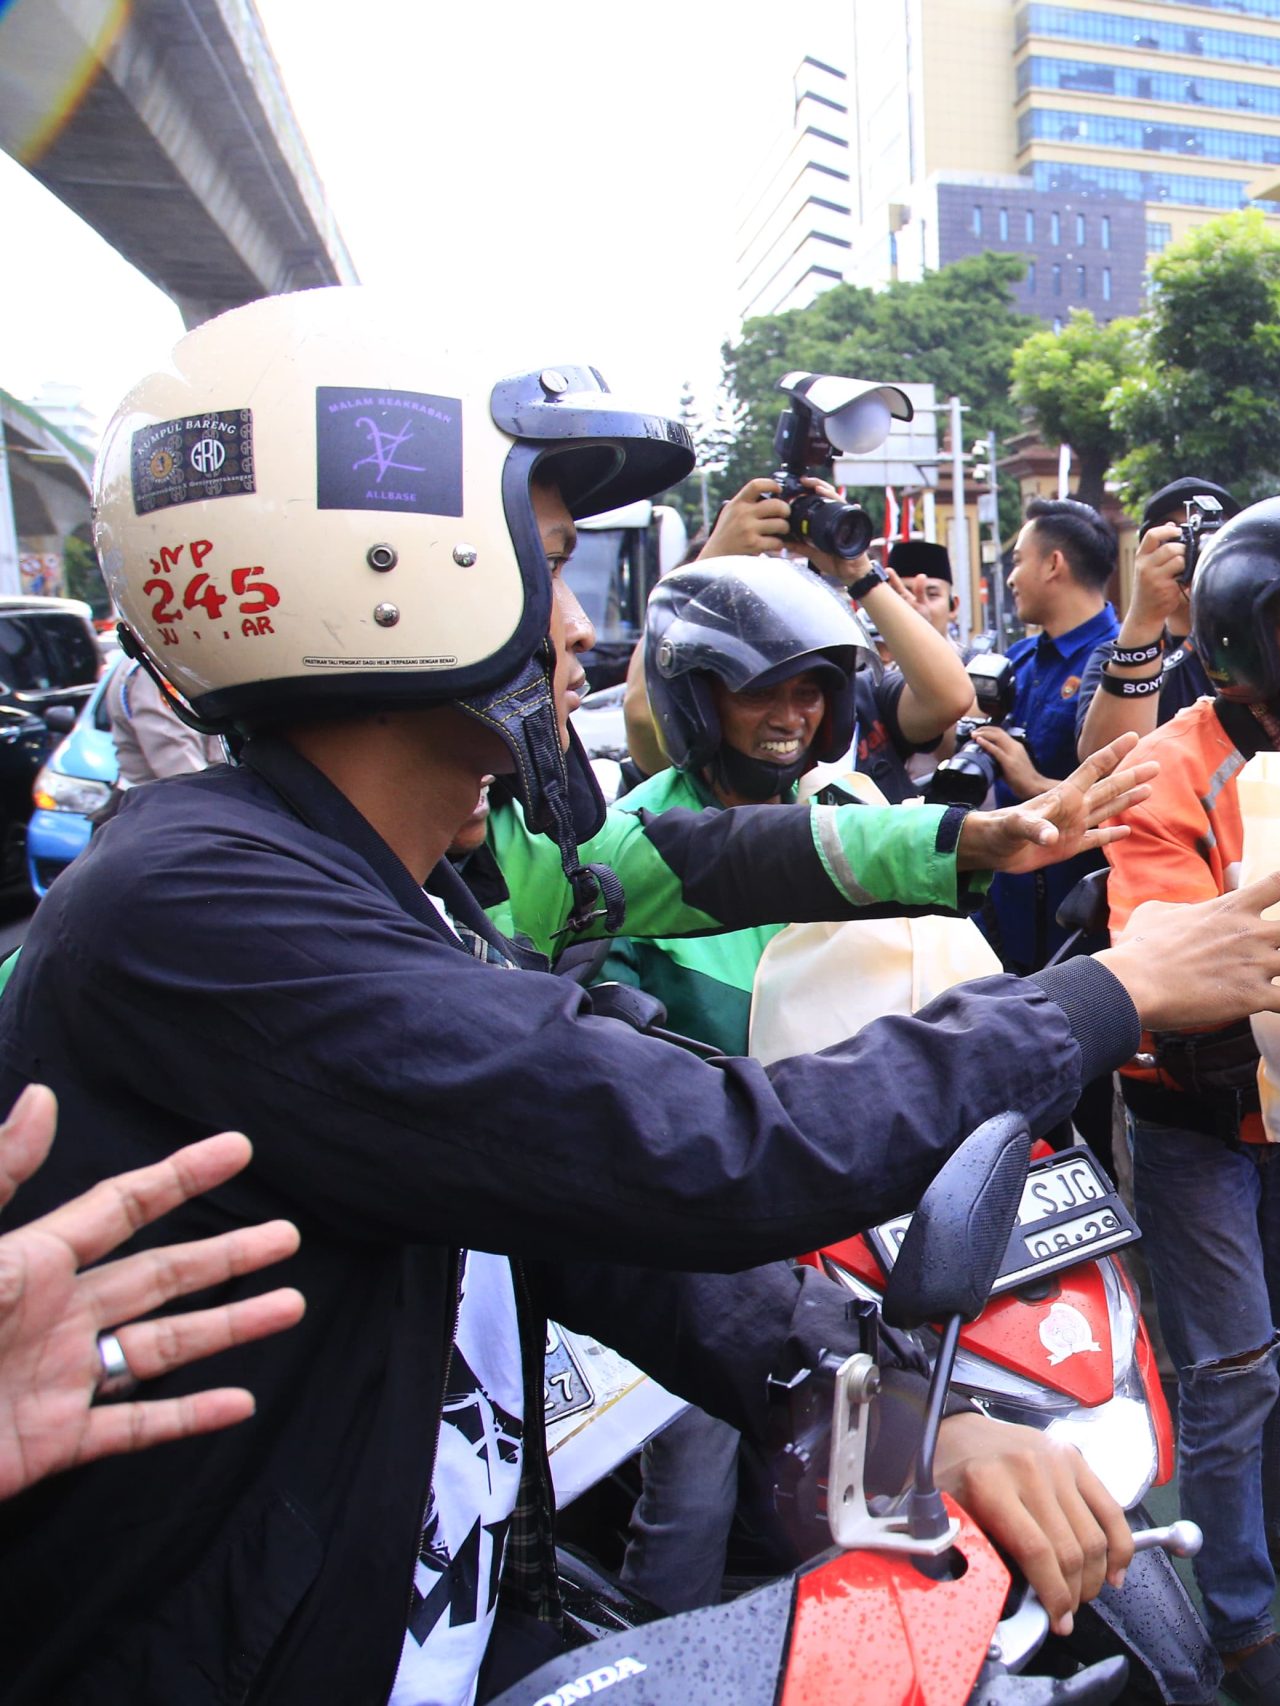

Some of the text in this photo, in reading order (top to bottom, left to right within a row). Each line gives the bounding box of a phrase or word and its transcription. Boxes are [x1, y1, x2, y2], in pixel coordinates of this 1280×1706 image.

[328, 398, 374, 413] MALAM
[186, 420, 237, 434] BARENG
[190, 438, 226, 474] GRD
[366, 490, 417, 502] ALLBASE
[143, 566, 280, 624] 245
[1112, 647, 1158, 662] SONY
[1031, 1168, 1098, 1216] SJG
